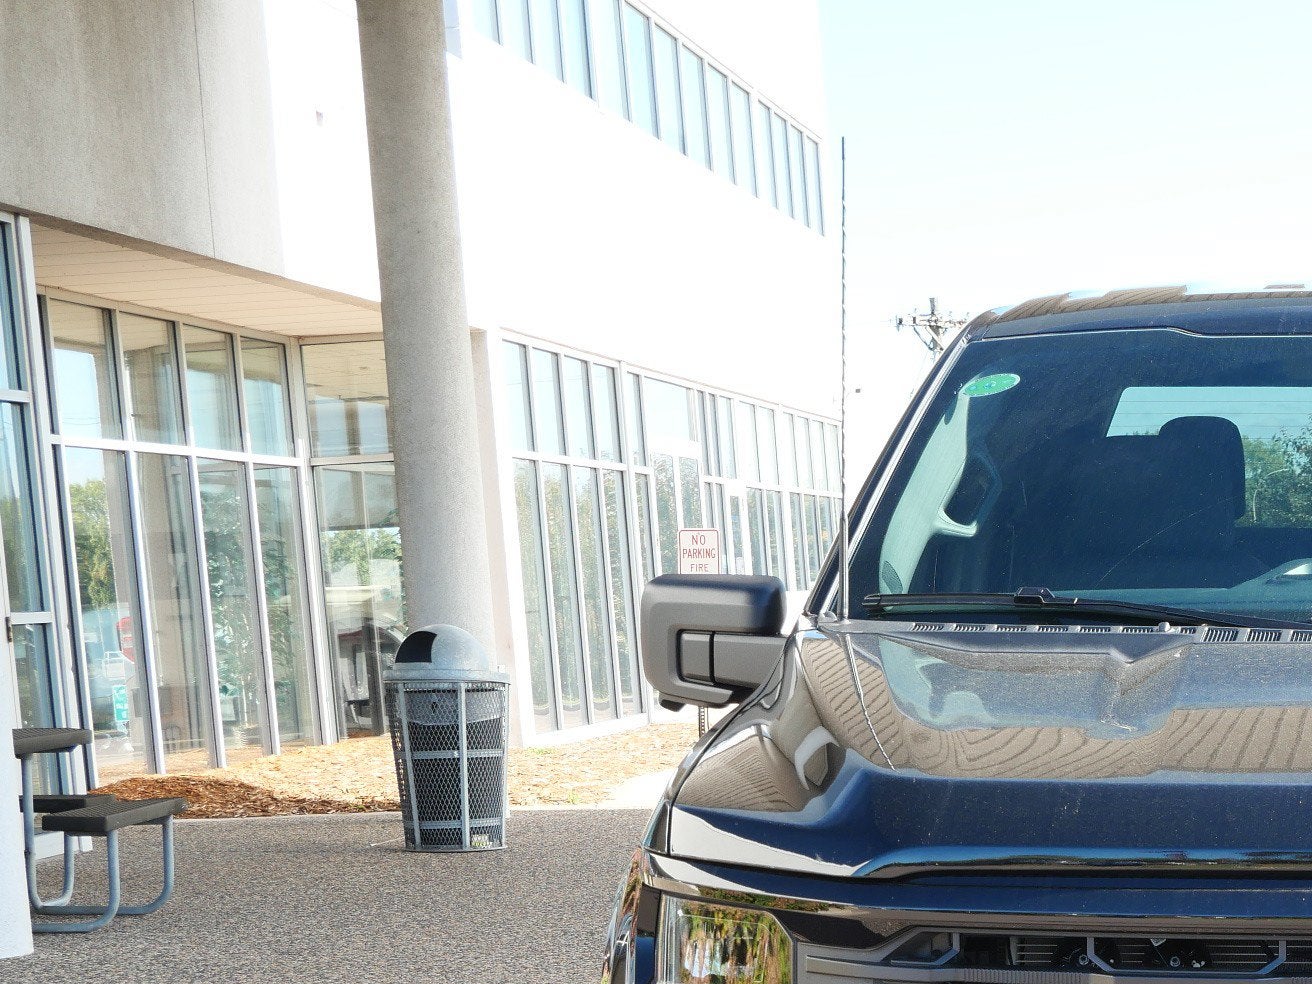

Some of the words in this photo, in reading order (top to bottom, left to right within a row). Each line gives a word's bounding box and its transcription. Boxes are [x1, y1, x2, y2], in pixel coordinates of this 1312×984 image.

[691, 534, 706, 545] NO
[682, 548, 716, 558] PARKING
[690, 563, 709, 572] FIRE
